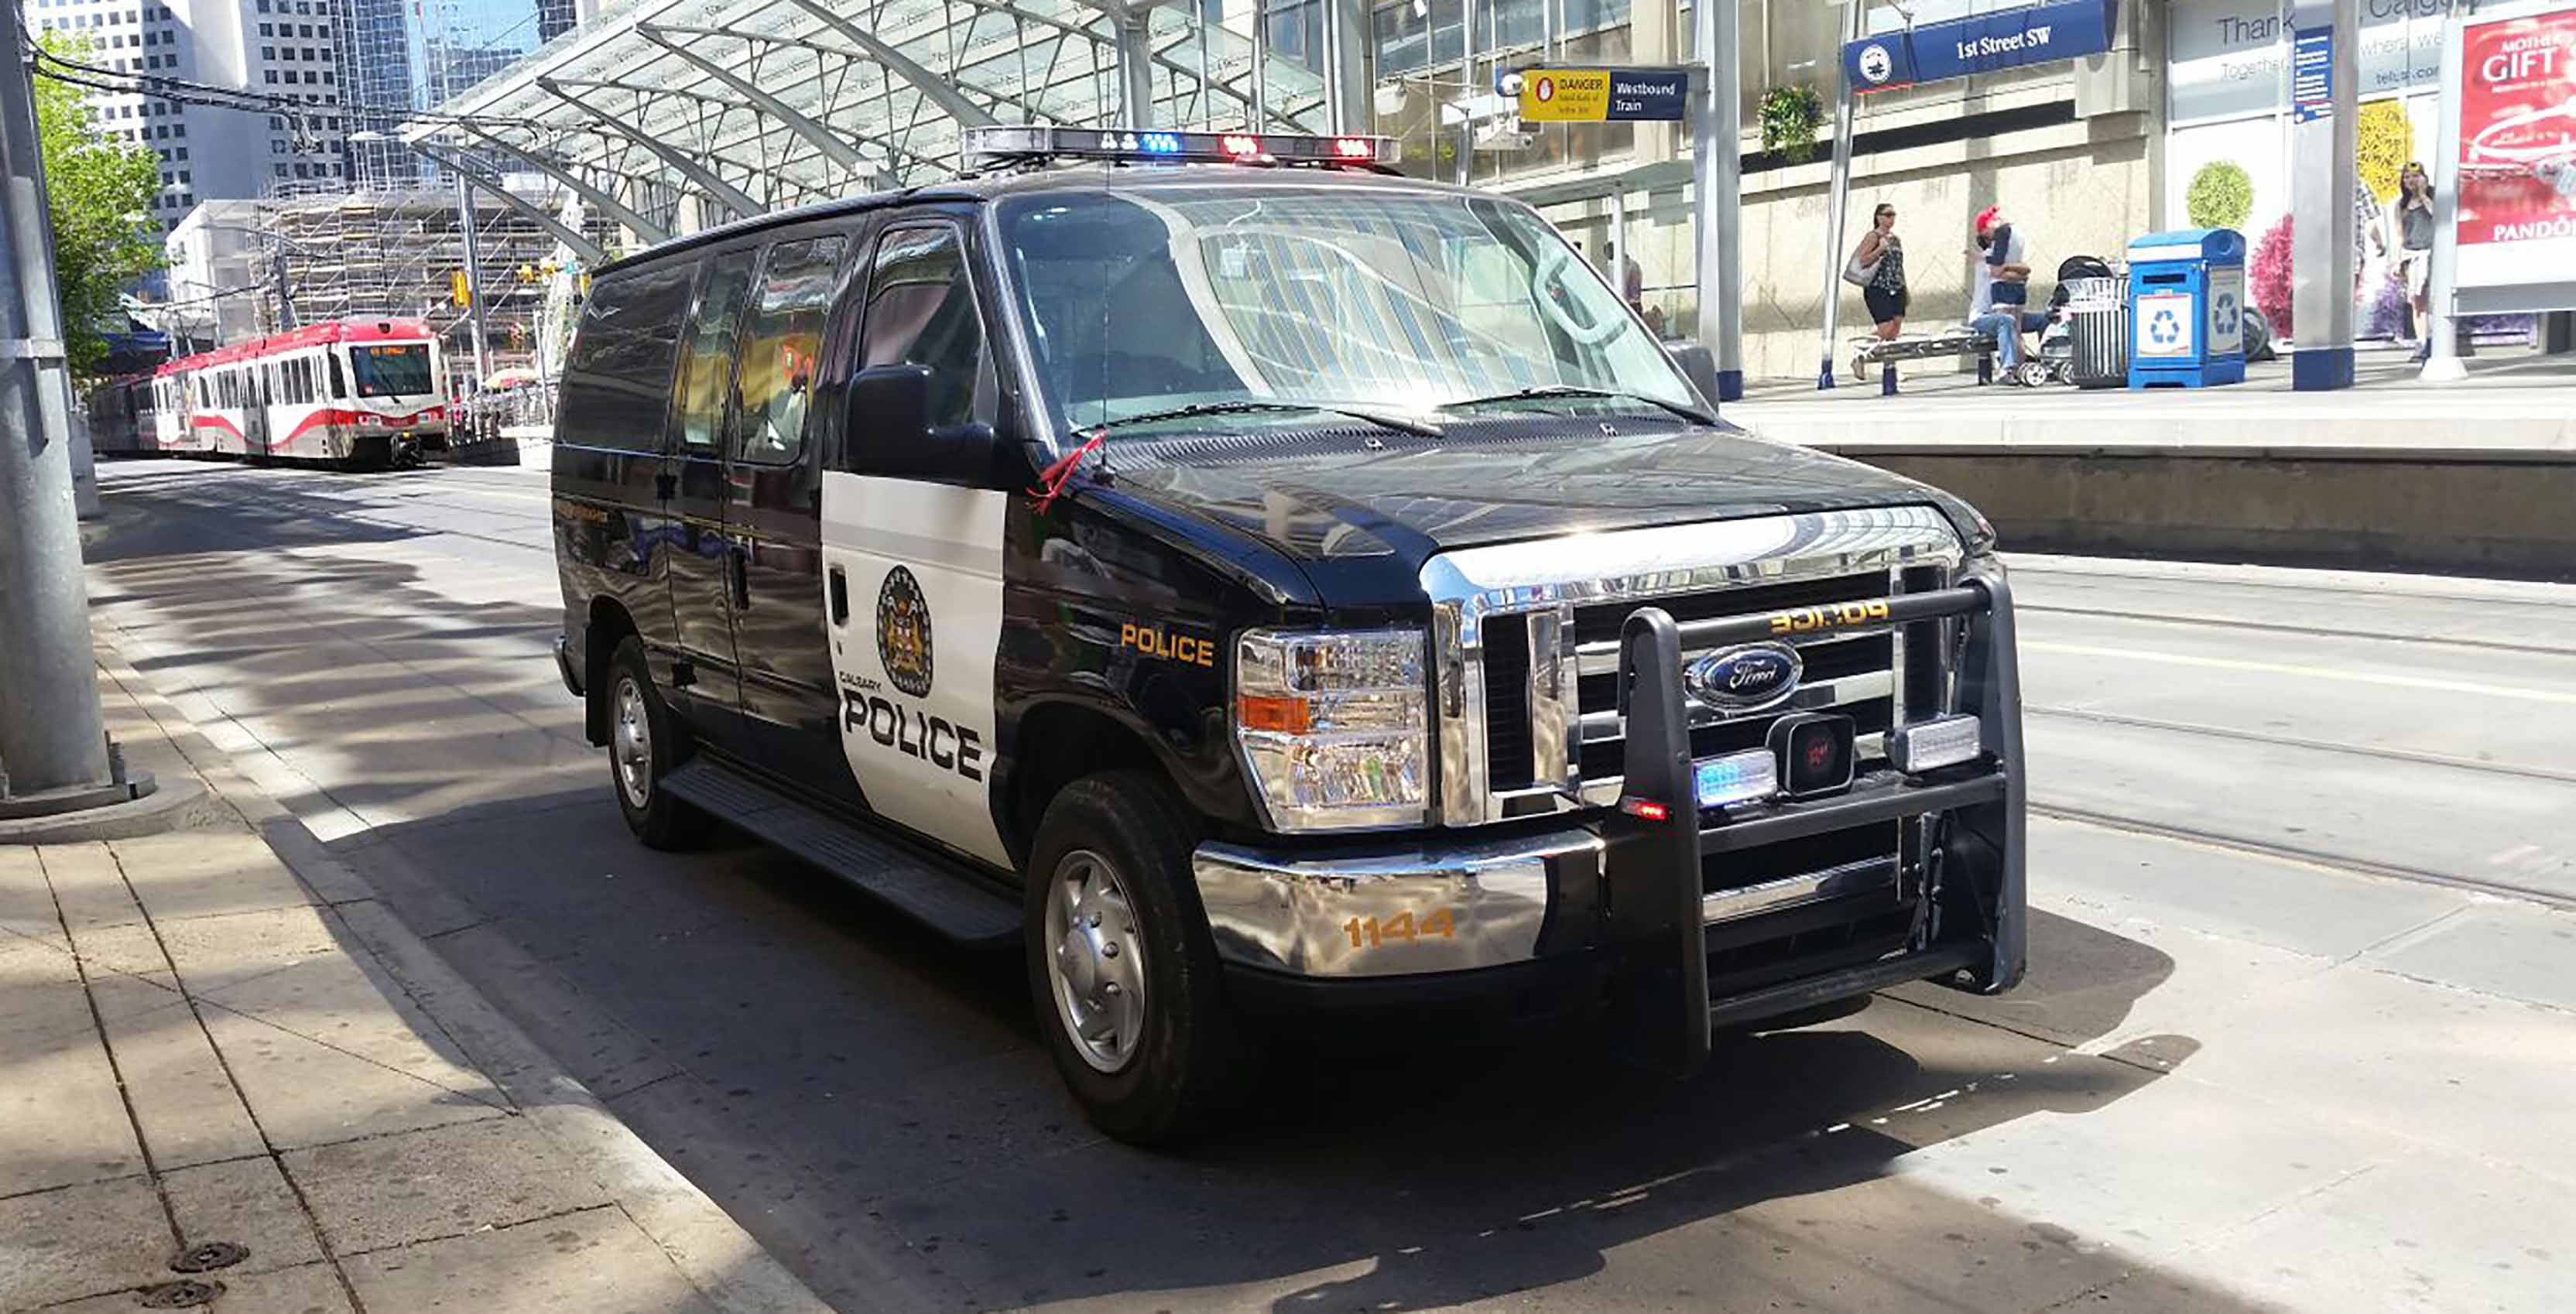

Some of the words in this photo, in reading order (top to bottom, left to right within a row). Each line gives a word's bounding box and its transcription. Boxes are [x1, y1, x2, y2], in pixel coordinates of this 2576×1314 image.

[1957, 41, 1978, 60] 1st
[1981, 33, 2026, 55] Street
[2026, 26, 2051, 47] SW
[2216, 12, 2296, 45] Thank
[2482, 46, 2557, 82] GIFT
[1558, 78, 1604, 91] DANGER
[1615, 82, 1677, 95] Westbound
[1615, 99, 1642, 112] Train
[2493, 217, 2576, 242] PANDO
[1121, 623, 1215, 667] POLICE
[1729, 659, 1778, 689] Ford
[843, 688, 982, 783] POLICE
[1343, 907, 1454, 950] 1144
